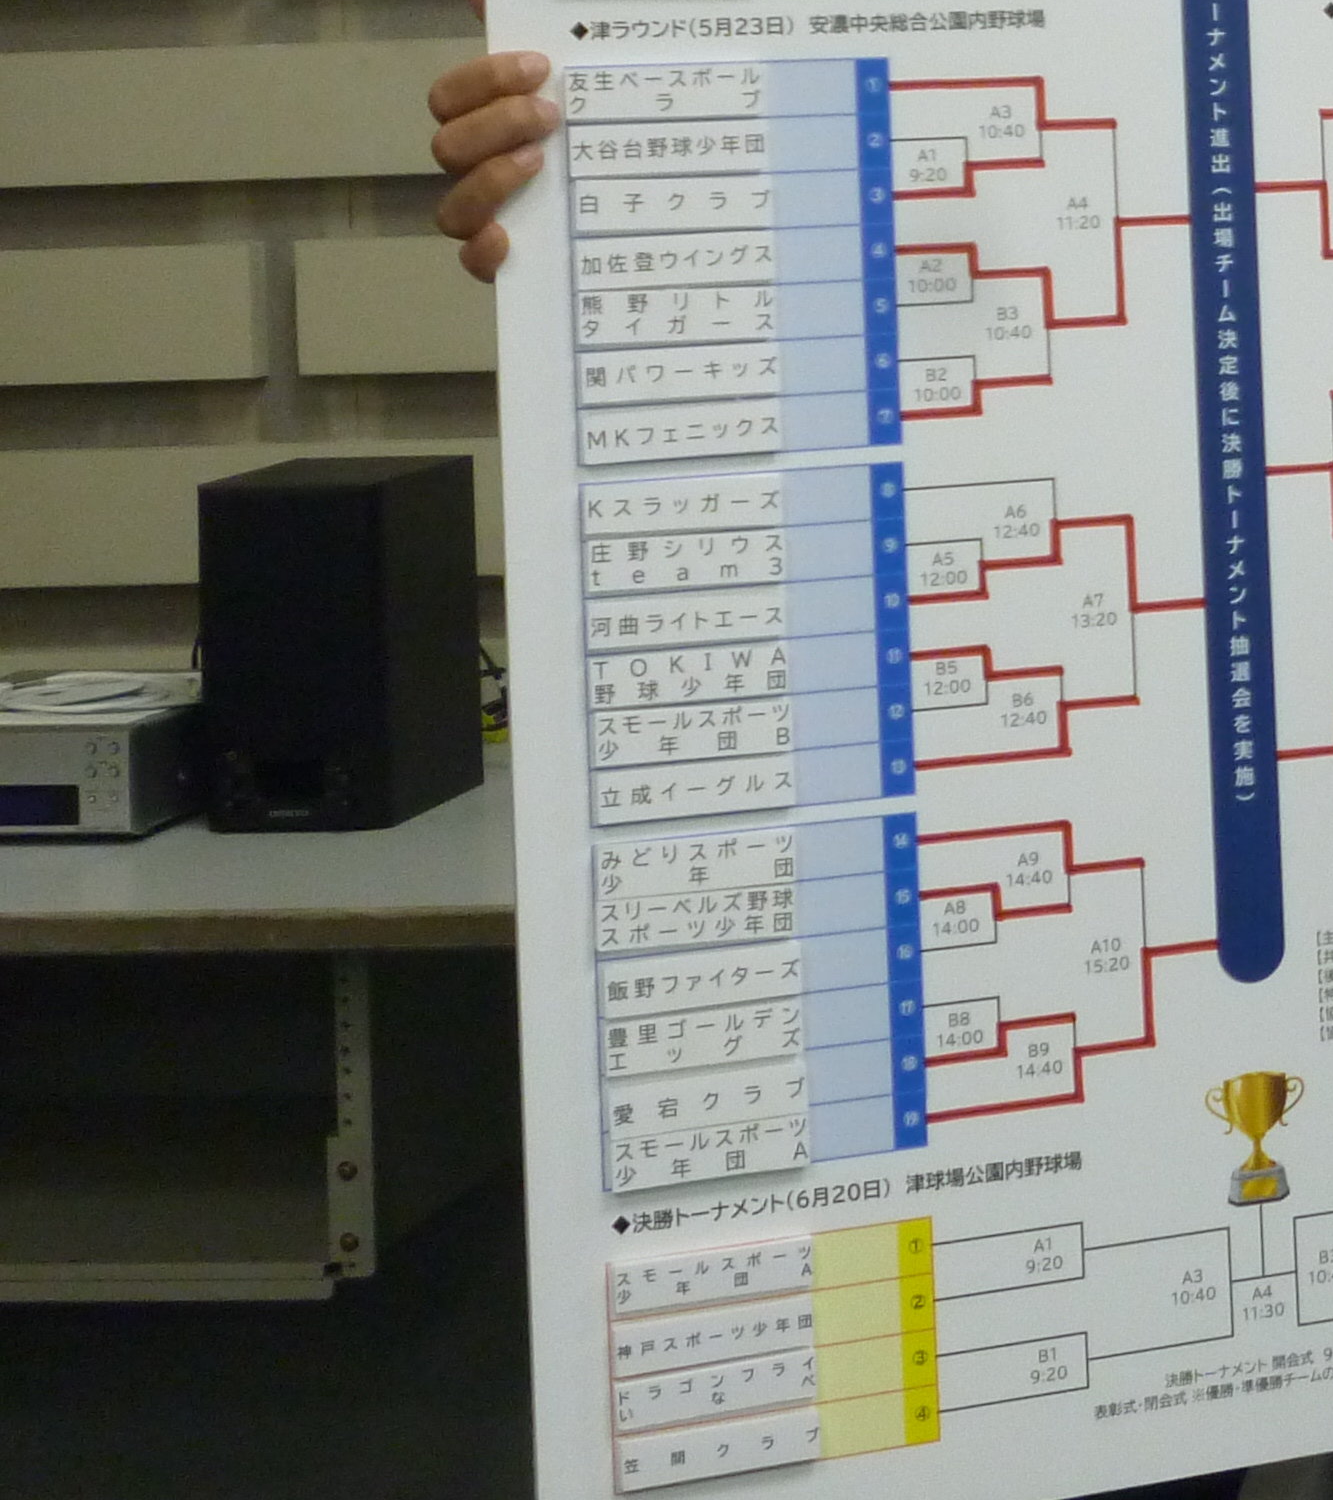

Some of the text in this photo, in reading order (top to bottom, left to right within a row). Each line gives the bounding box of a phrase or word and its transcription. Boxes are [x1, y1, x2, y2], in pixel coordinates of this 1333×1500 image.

[568, 68, 760, 93] 友生ベースボール
[571, 132, 766, 162] 大谷台野球少年団
[578, 190, 770, 215] 白子クラブ
[1056, 214, 1100, 230] 11:20
[580, 245, 772, 276] 加佐登ウイングス
[986, 324, 1032, 341] 10:40
[993, 523, 1041, 540] 12:40
[590, 606, 783, 638] 河曲ライトエース
[594, 670, 787, 705] 野球少年団
[598, 704, 790, 737] スモールスポーツ
[600, 834, 794, 871] みどりスポーツ
[602, 912, 793, 947] スポーツ少年団
[607, 958, 800, 1002] 飯野ファイターズ
[615, 1117, 806, 1162] スモールスポーツ
[905, 1151, 1083, 1194] 津球場公園内野球場
[1026, 1255, 1064, 1274] 9:20
[1242, 1302, 1285, 1321] 11:30
[617, 1314, 812, 1359] 神戸スポーツ少年団
